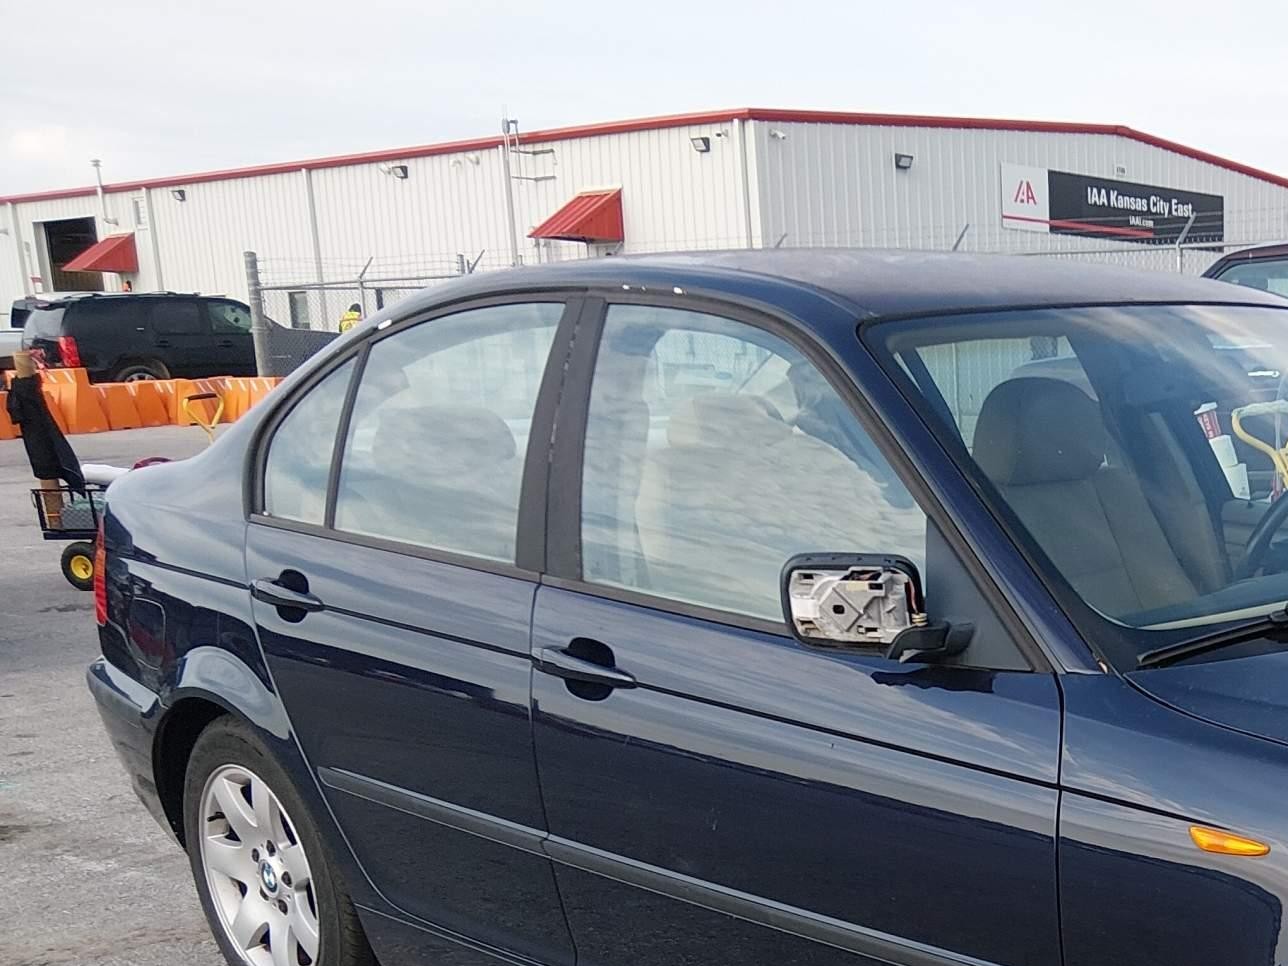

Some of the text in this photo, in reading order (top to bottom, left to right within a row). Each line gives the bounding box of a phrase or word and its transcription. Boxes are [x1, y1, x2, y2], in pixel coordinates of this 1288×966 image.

[1087, 186, 1193, 218] IAA Kansas City East
